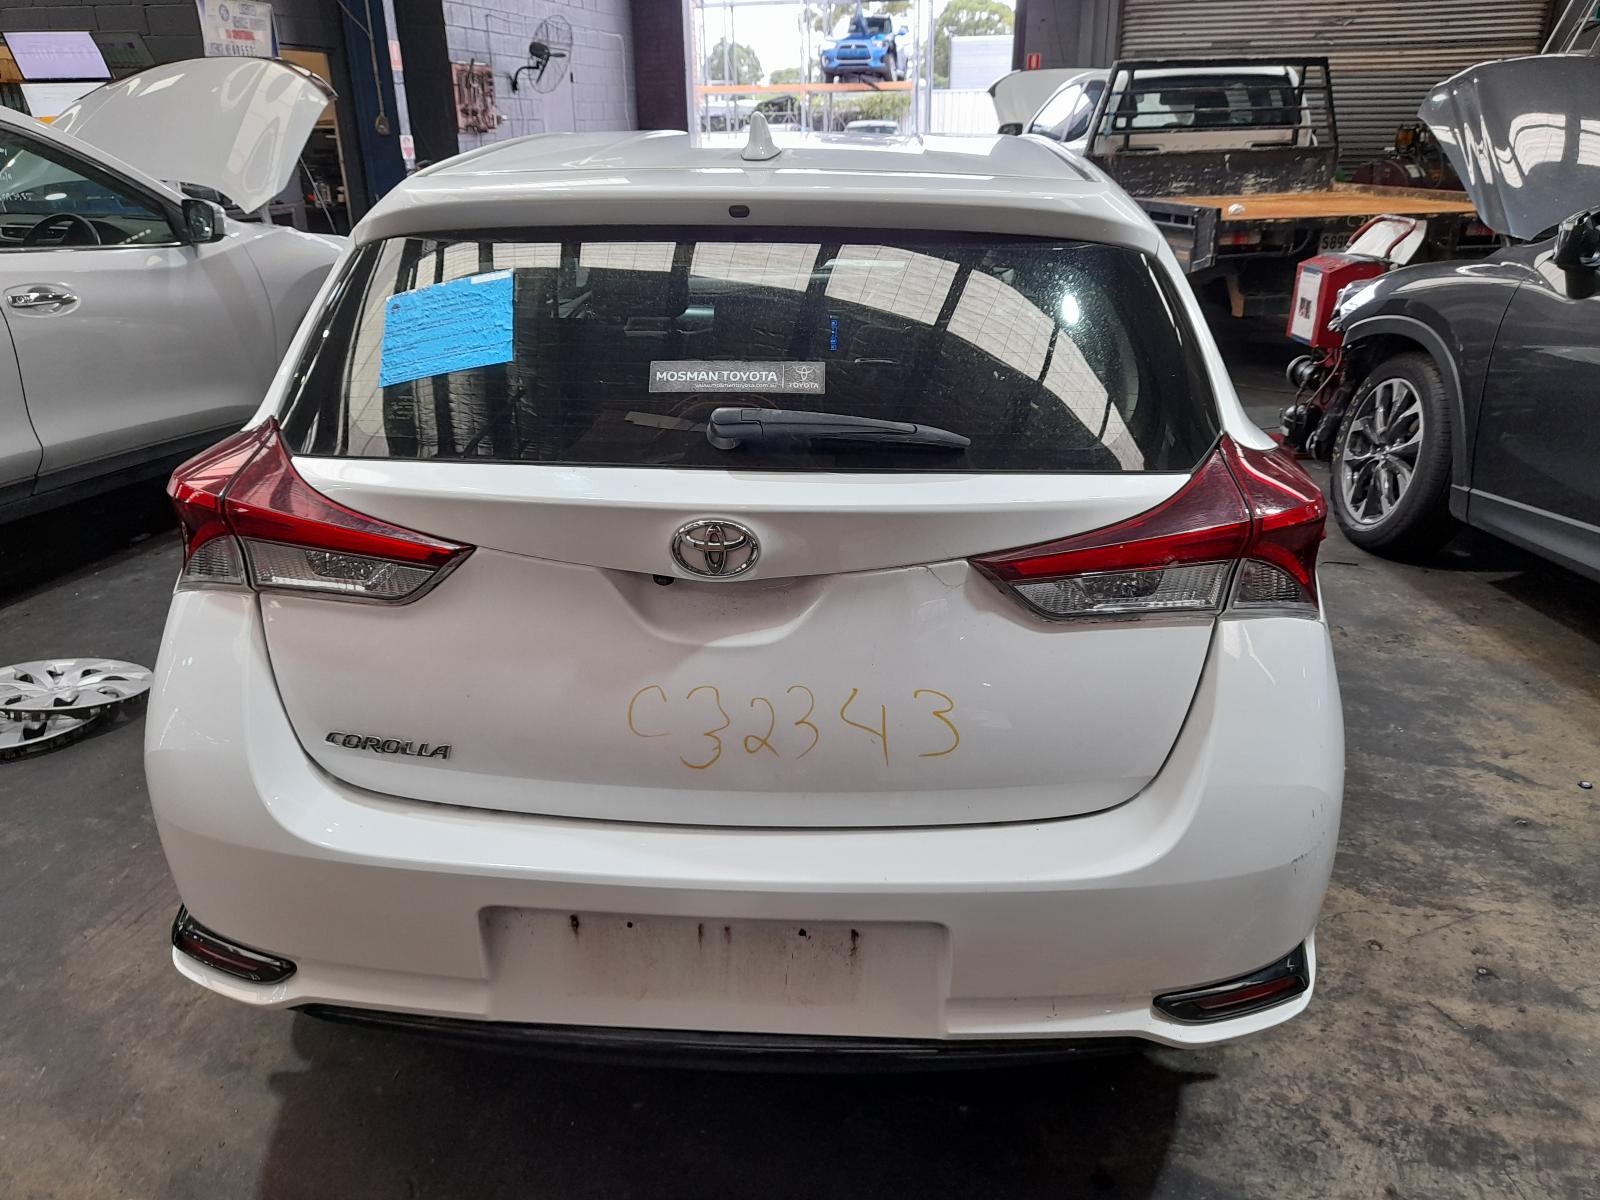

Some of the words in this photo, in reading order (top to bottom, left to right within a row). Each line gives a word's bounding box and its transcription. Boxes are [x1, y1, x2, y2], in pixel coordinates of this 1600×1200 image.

[656, 371, 718, 382] MOSMAN
[721, 371, 778, 382] TOYOTA
[628, 685, 960, 769] C32343
[324, 731, 452, 760] COROLLA
